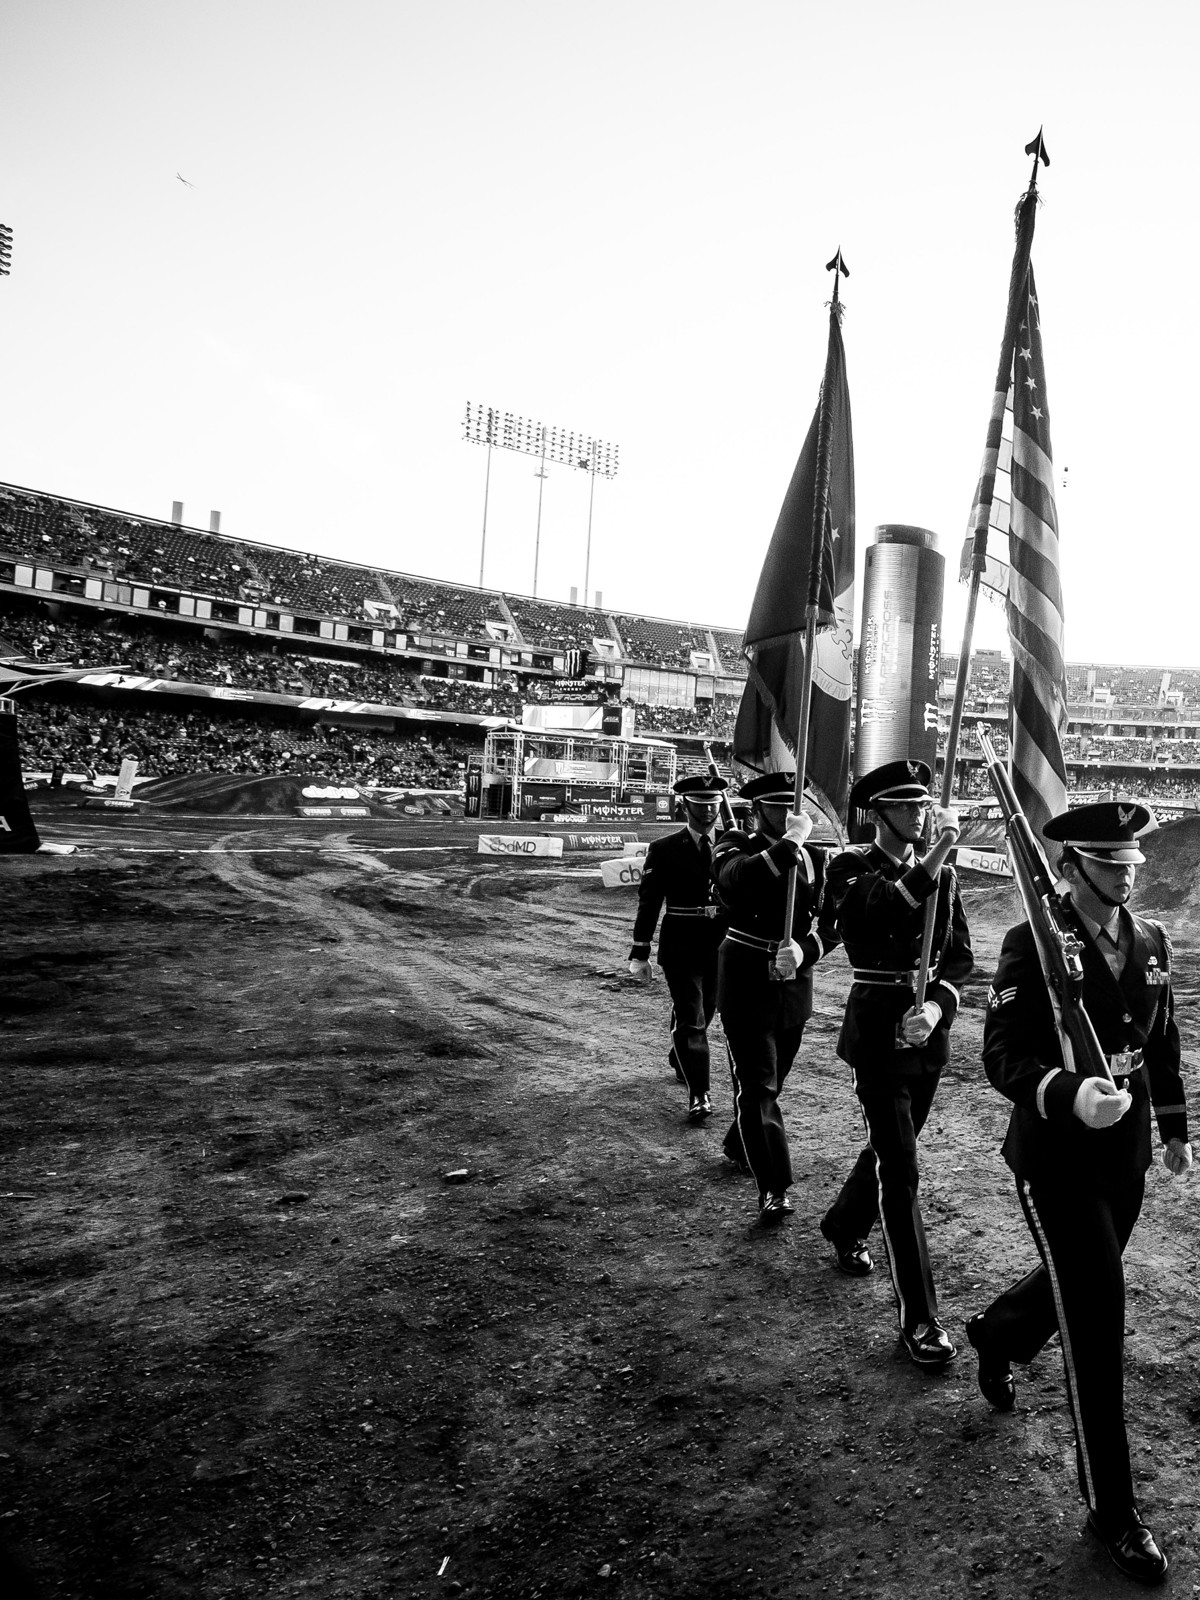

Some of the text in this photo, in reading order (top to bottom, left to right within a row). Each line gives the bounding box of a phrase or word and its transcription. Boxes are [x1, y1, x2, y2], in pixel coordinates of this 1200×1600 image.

[928, 623, 938, 680] MONSTER
[555, 680, 587, 688] MONSTER
[541, 693, 599, 701] SUPERCROSS
[592, 805, 645, 816] MONSTER
[581, 834, 623, 845] MONSTER
[490, 839, 537, 854] cbdMD
